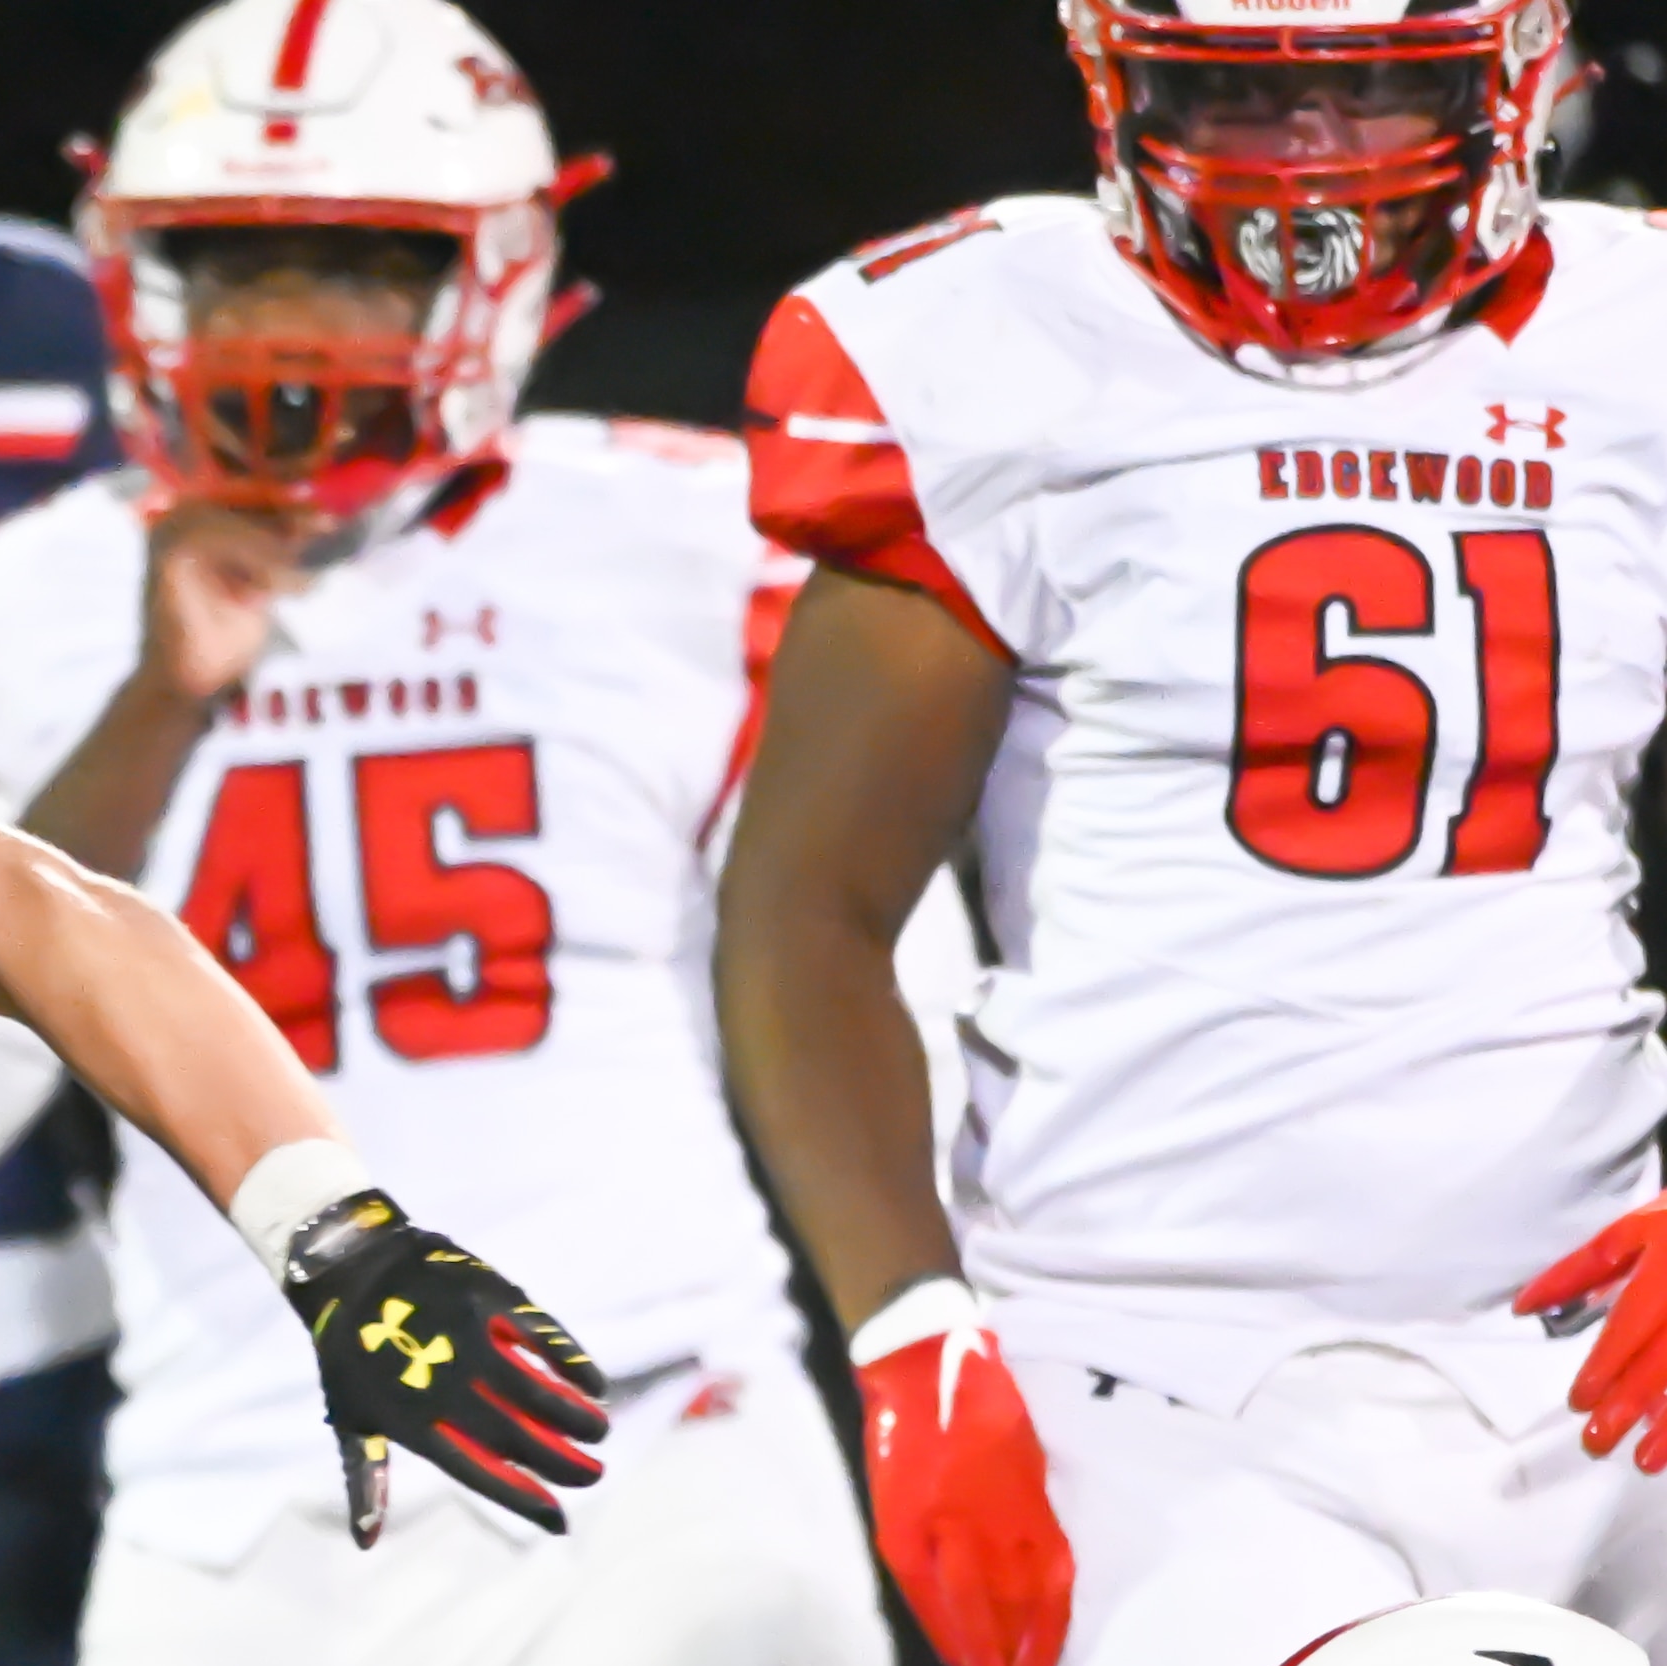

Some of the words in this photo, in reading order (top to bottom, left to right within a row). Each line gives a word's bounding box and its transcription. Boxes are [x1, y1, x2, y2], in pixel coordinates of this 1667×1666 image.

[1255, 448, 1554, 510] EDGEWOOD
[1224, 523, 1561, 881] 61
[179, 737, 556, 1075] 45
